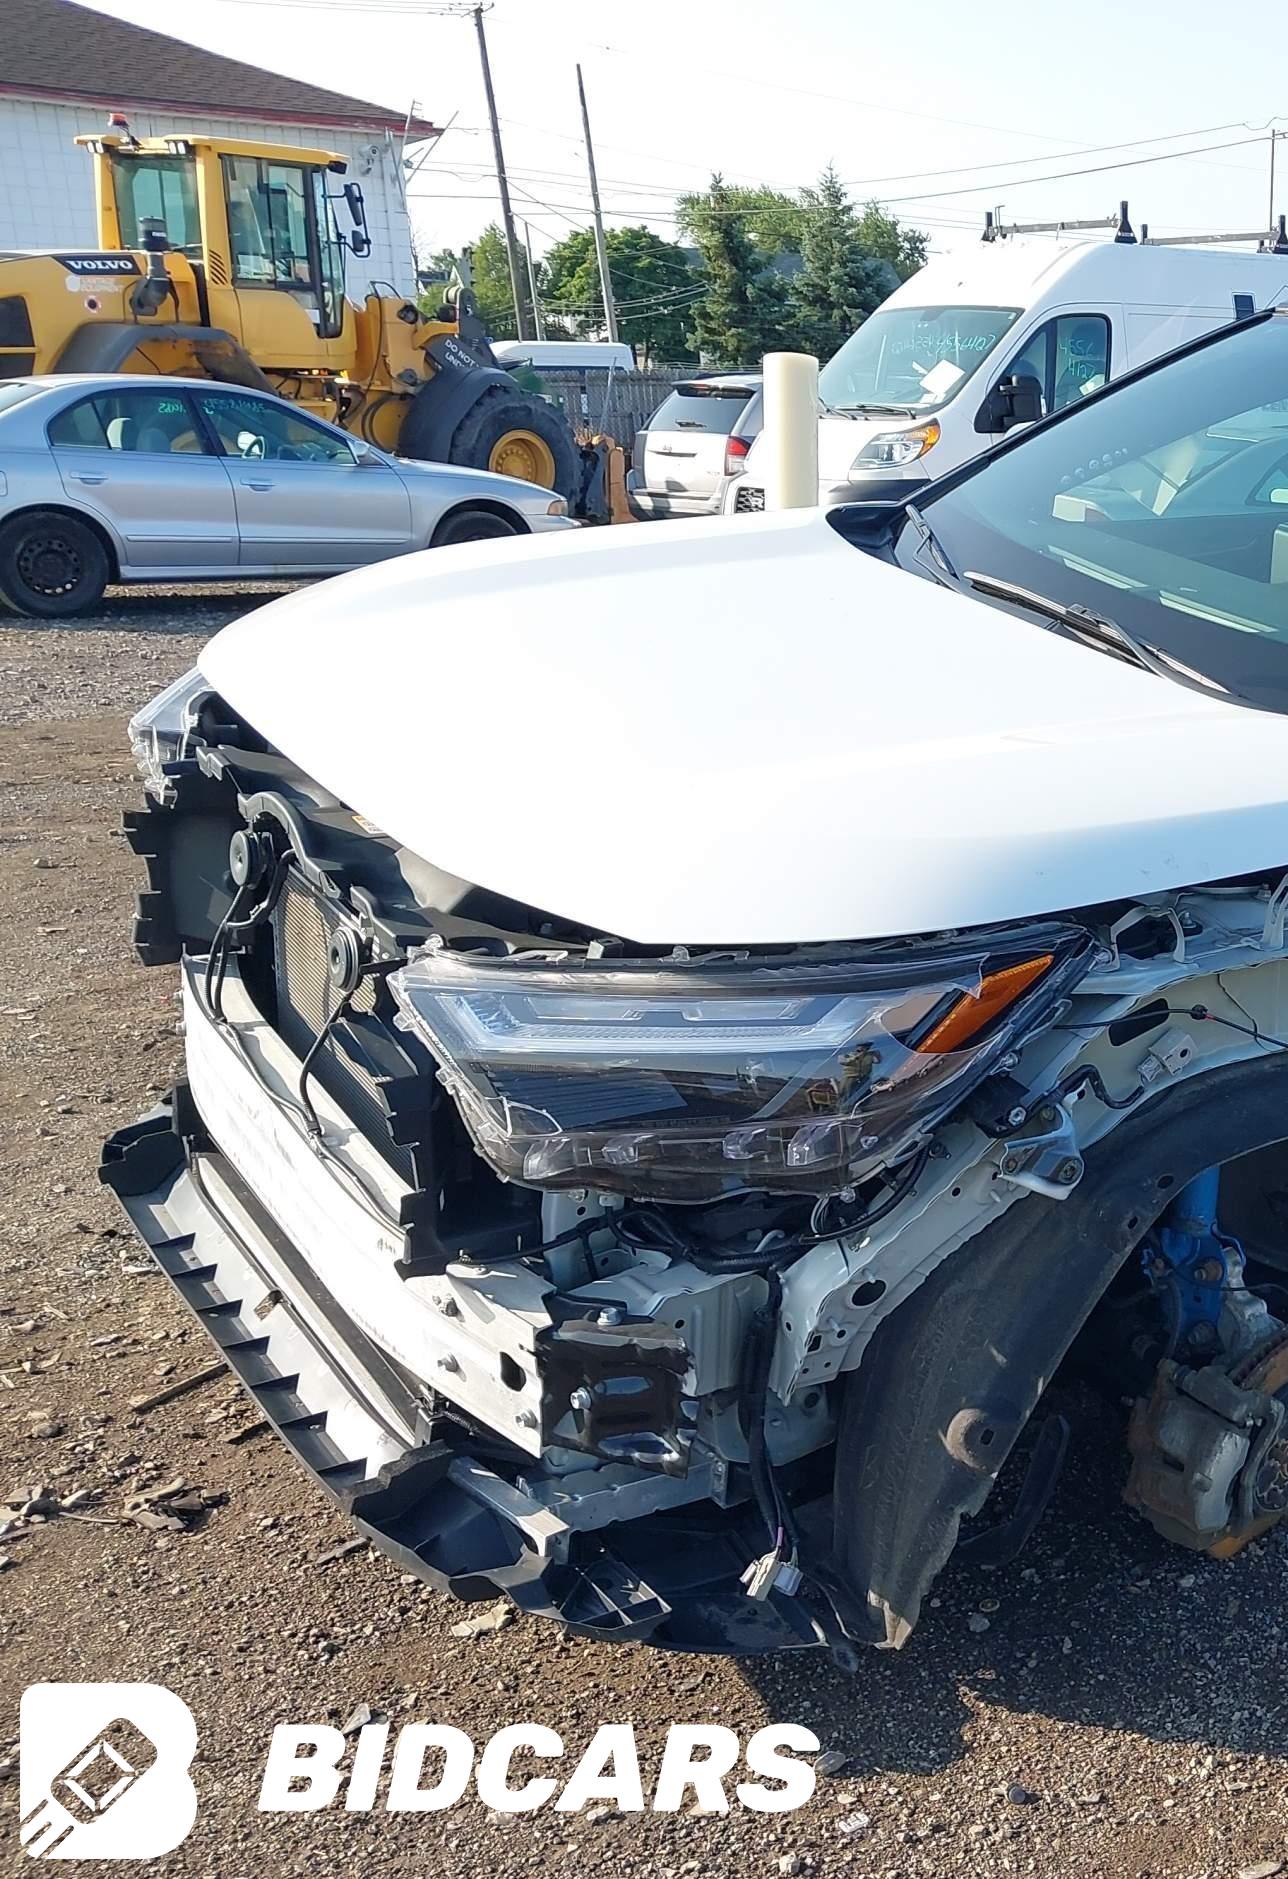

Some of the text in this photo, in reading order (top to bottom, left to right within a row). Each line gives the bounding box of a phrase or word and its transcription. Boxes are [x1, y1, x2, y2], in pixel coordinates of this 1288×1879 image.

[66, 260, 133, 270] VOLVO
[444, 339, 459, 353] DO
[458, 350, 477, 368] NOT
